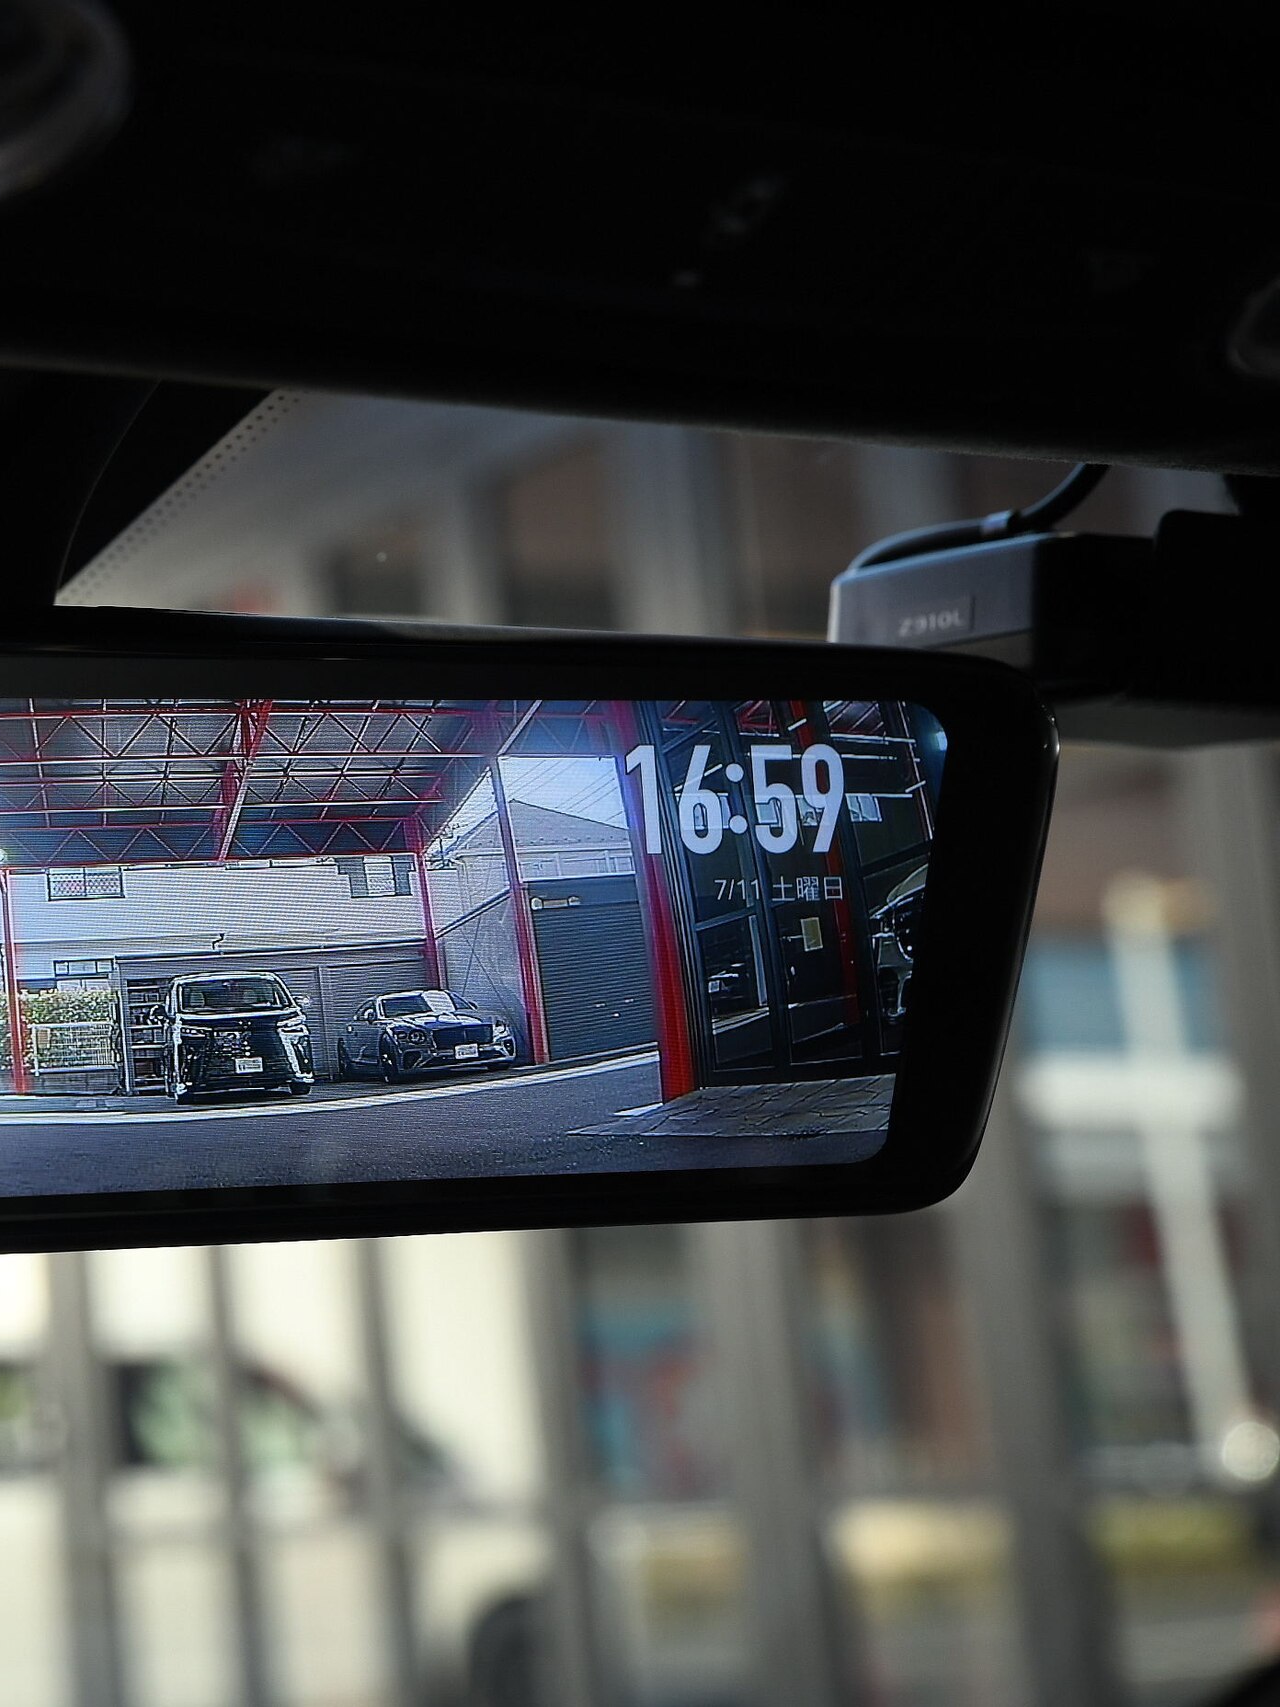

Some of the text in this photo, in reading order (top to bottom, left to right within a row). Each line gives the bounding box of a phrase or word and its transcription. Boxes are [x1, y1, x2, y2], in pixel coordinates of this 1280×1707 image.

[626, 744, 844, 855] 16:59
[714, 876, 843, 902] 7/11 土曜日
